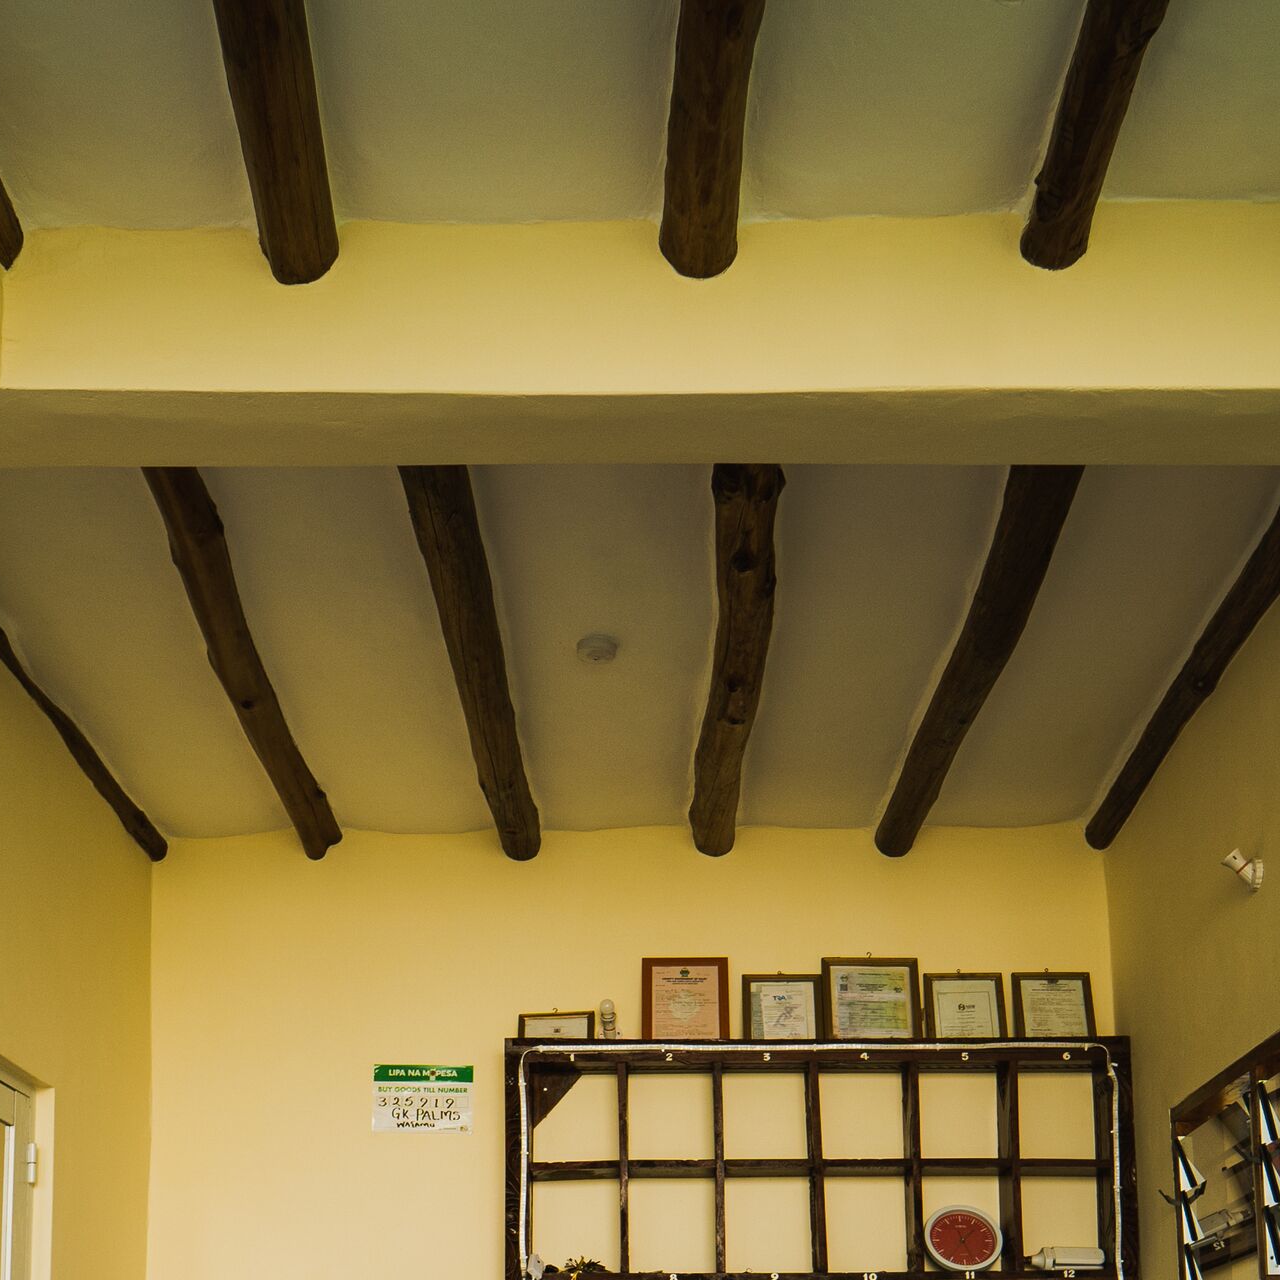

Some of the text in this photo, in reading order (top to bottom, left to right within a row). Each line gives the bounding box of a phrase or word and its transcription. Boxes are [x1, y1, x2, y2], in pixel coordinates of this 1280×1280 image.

[569, 1053, 575, 1062] 1
[665, 1053, 673, 1061] 2
[763, 1053, 771, 1061] 3
[860, 1052, 869, 1061] 4
[961, 1052, 969, 1061] 5
[1062, 1052, 1071, 1060] 6
[388, 1069, 405, 1077] LIPA
[391, 1108, 461, 1121] GK PALMS
[965, 1271, 975, 1280] 11
[1063, 1270, 1076, 1278] 12
